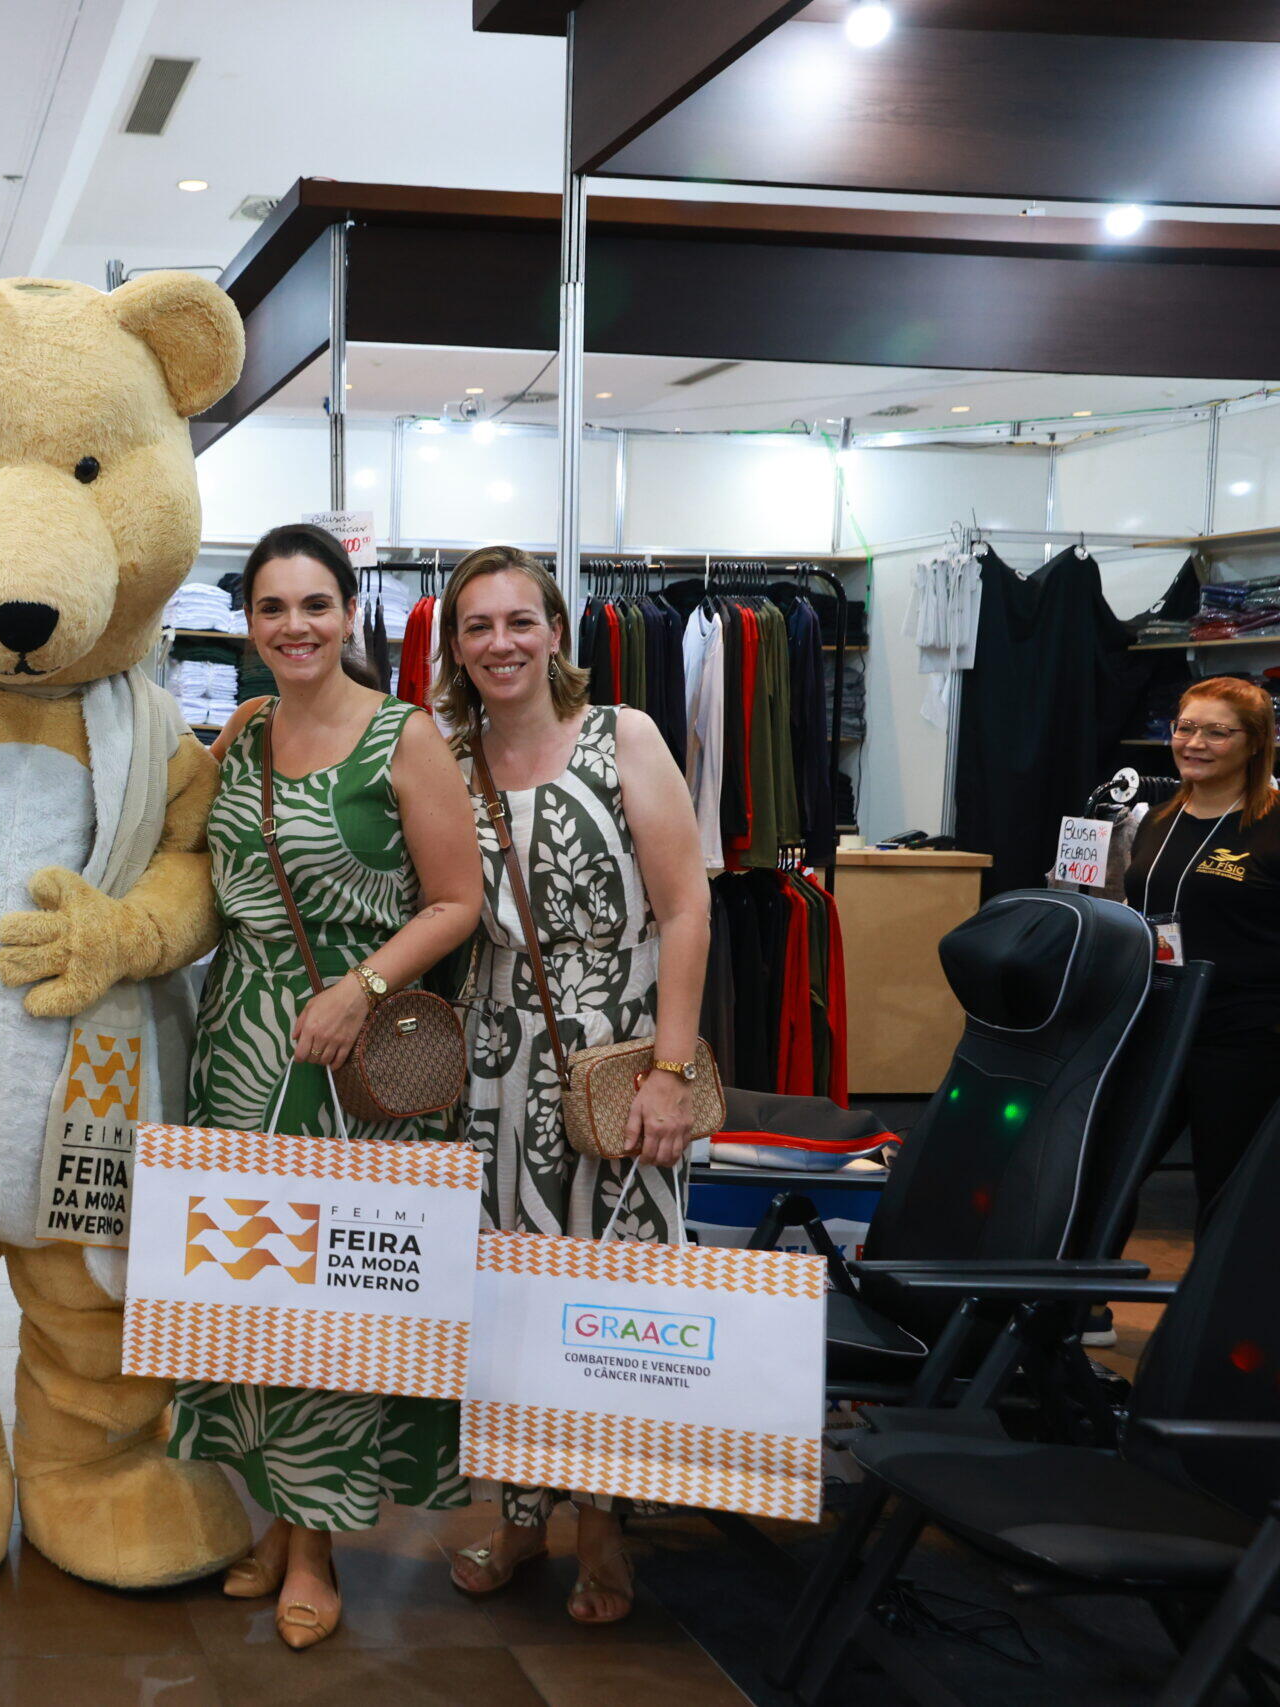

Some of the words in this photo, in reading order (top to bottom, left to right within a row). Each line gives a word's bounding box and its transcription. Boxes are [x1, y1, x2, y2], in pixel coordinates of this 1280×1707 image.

[1064, 819, 1096, 841] BLUSA
[63, 1123, 133, 1146] FEIMI
[57, 1154, 128, 1189] FEIRA
[52, 1187, 79, 1208] DA
[85, 1191, 126, 1213] MODA
[48, 1211, 124, 1236] INVERNO
[331, 1205, 425, 1223] FEIMI
[329, 1228, 422, 1256] FEIRA
[328, 1254, 355, 1269] DA
[362, 1256, 420, 1274] MODA
[326, 1272, 420, 1293] INVERNO
[575, 1313, 701, 1348] GRAACC
[564, 1352, 639, 1369] COMBATENDO
[642, 1359, 649, 1370] E
[651, 1360, 711, 1377] VENCENDO
[584, 1367, 592, 1377] O
[594, 1366, 637, 1383] CÂNCER
[640, 1372, 690, 1388] INFANTIL
